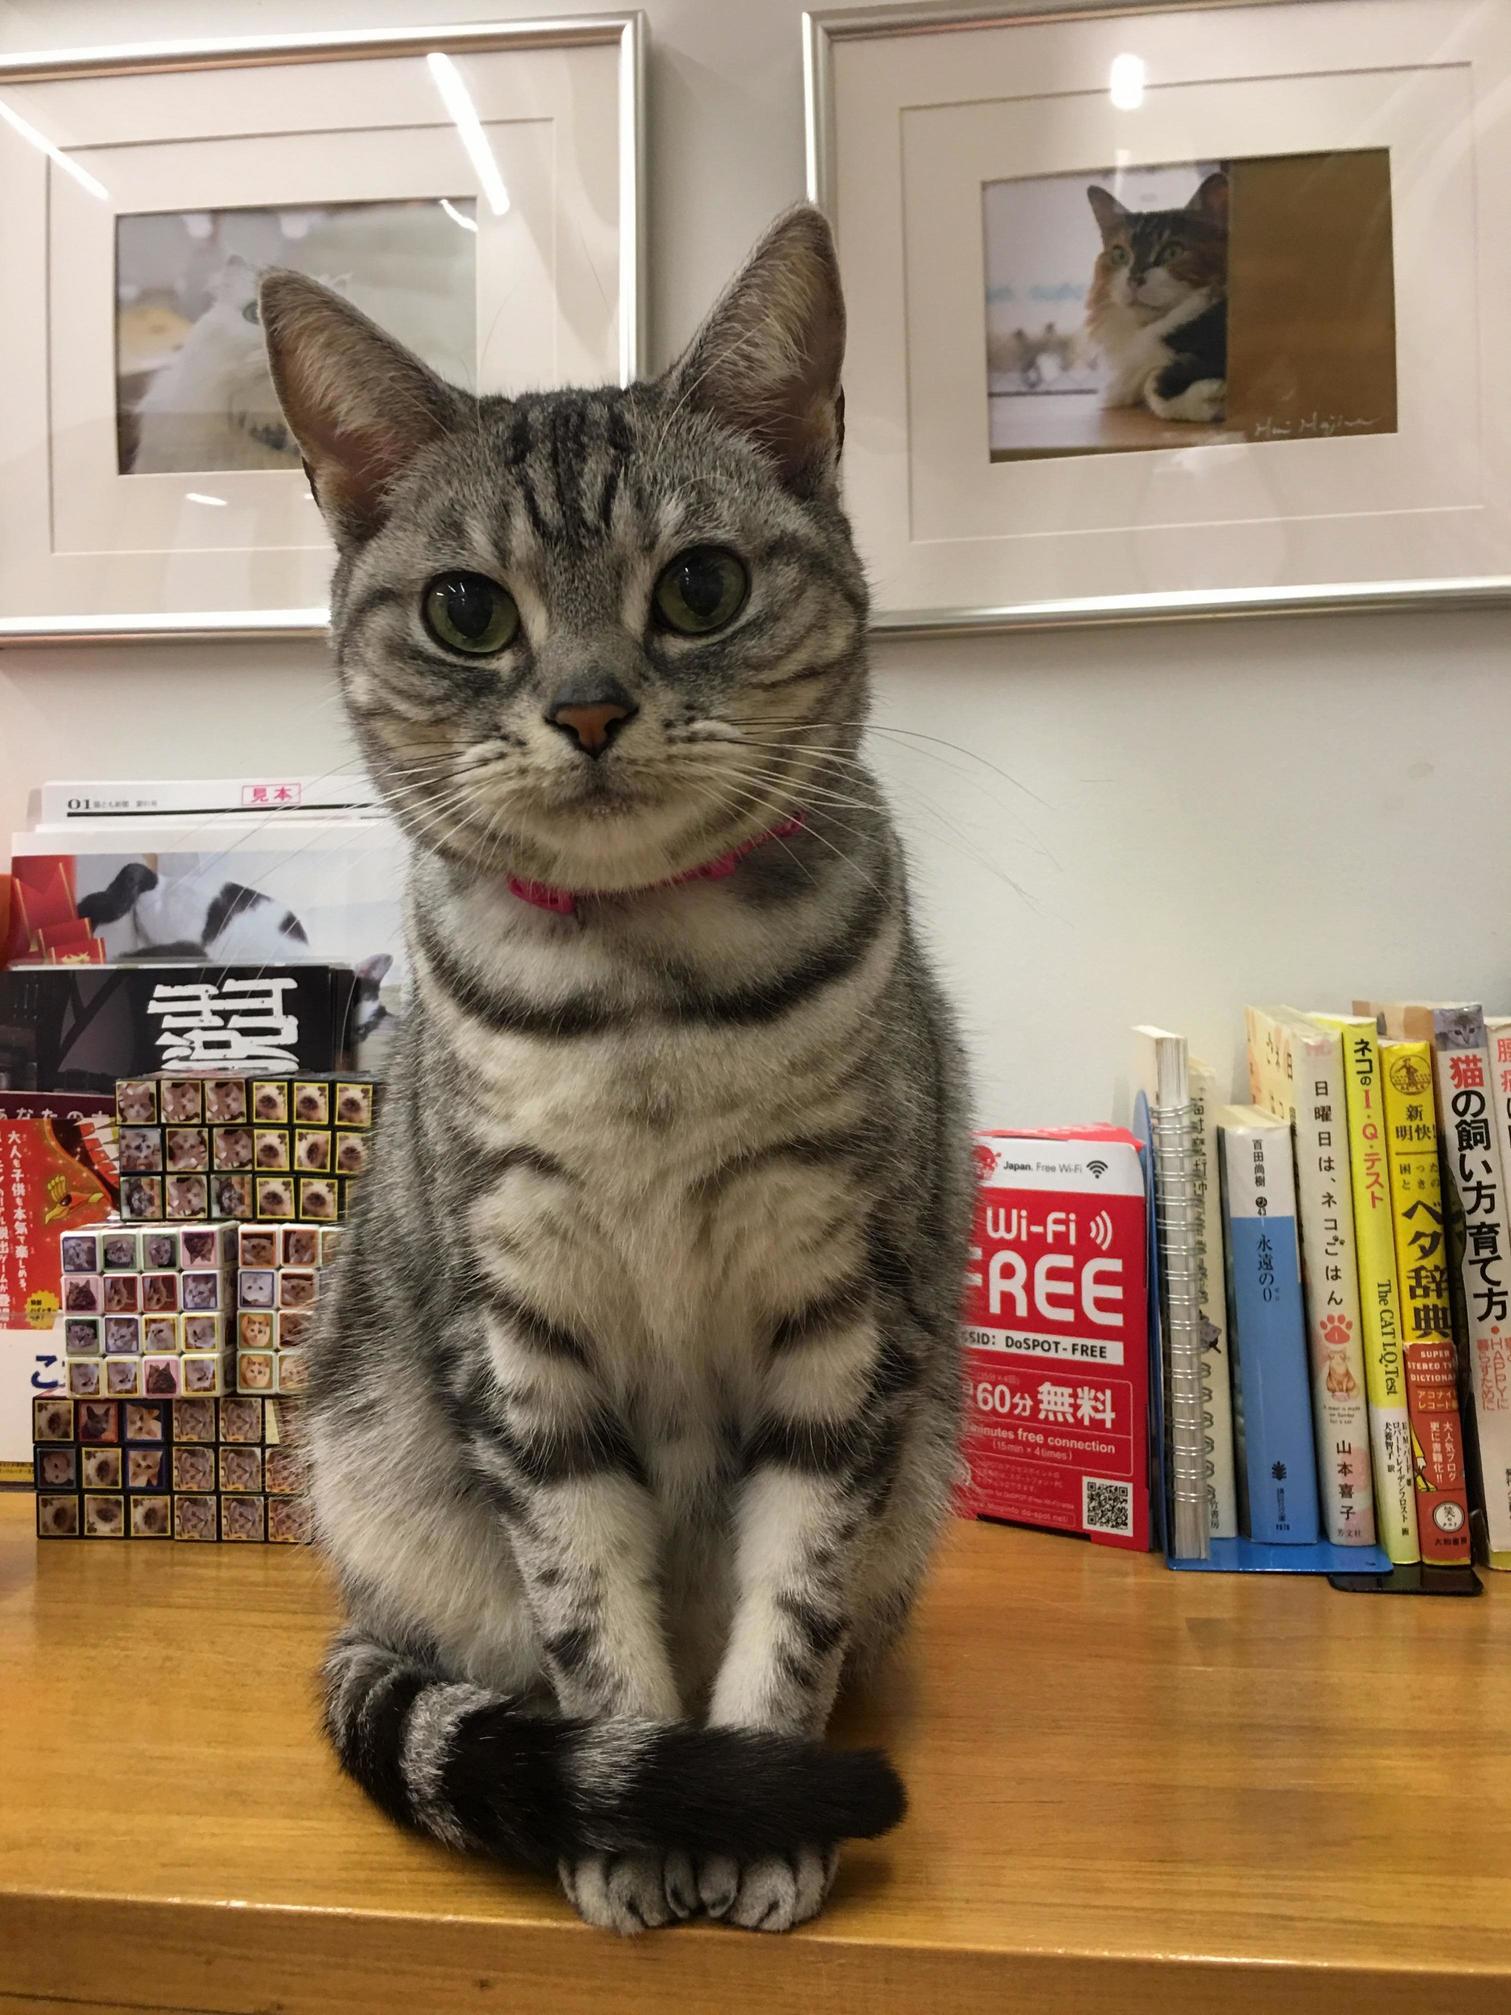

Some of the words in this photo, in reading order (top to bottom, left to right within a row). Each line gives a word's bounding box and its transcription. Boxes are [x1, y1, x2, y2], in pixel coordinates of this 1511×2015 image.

[252, 787, 291, 802] 見本
[1405, 1104, 1423, 1121] 新
[1036, 1162, 1057, 1173] Free
[1059, 1163, 1083, 1174] Wi-Fi
[1252, 1139, 1266, 1187] 百田尚樹
[1314, 1080, 1345, 1306] 日曜日は、ネコごはん
[986, 1206, 1077, 1246] Wi-Fi
[1401, 1199, 1451, 1339] ベタ辞典
[1377, 1280, 1392, 1306] The
[1379, 1309, 1396, 1339] CAT
[1420, 1350, 1450, 1358] SUPER
[1017, 1428, 1045, 1444] free
[1047, 1435, 1116, 1454] connection
